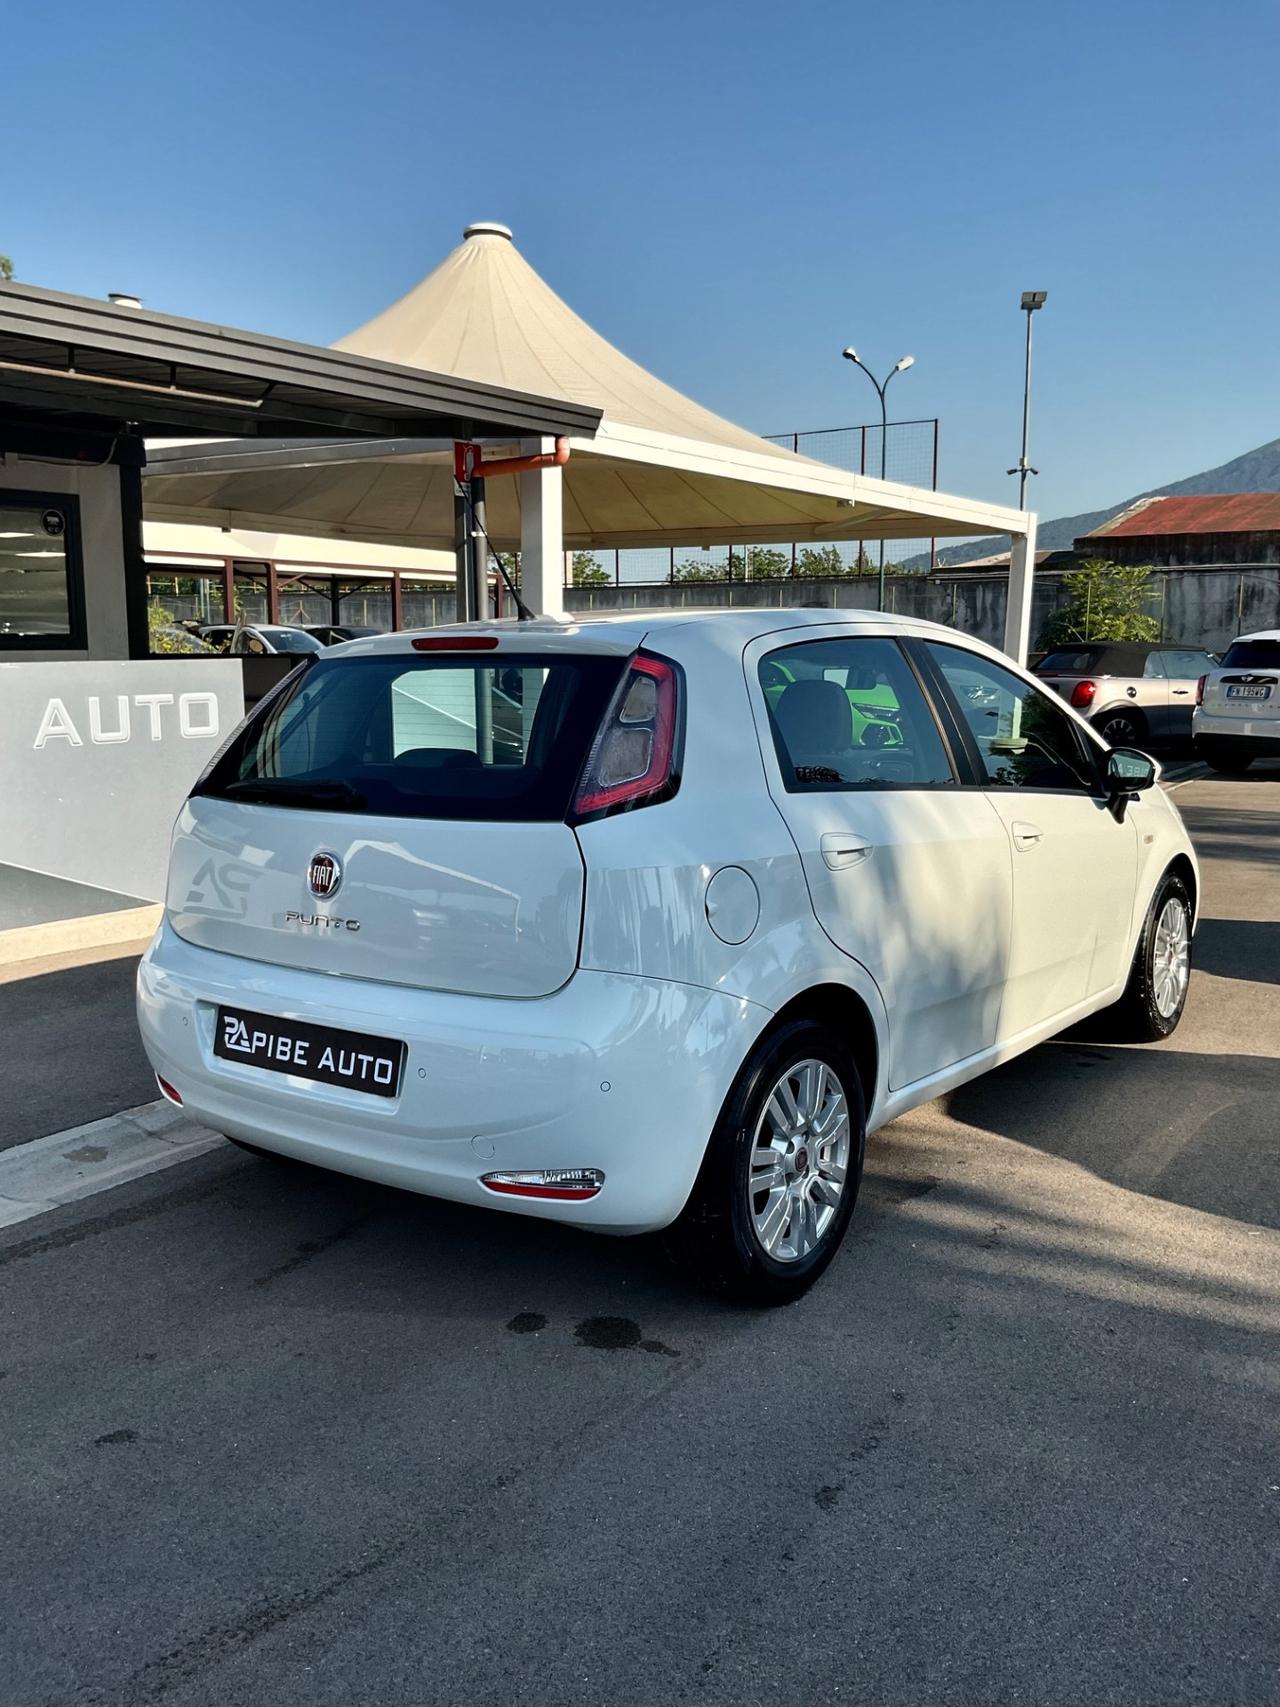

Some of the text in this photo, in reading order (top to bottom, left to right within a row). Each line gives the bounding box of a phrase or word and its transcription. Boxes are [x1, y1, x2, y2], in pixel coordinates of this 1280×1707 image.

[33, 692, 219, 749] AUTO
[313, 865, 332, 886] FIAT
[285, 911, 361, 931] PUNTO
[251, 1031, 310, 1066] PIBE
[317, 1047, 393, 1085] AUTO
